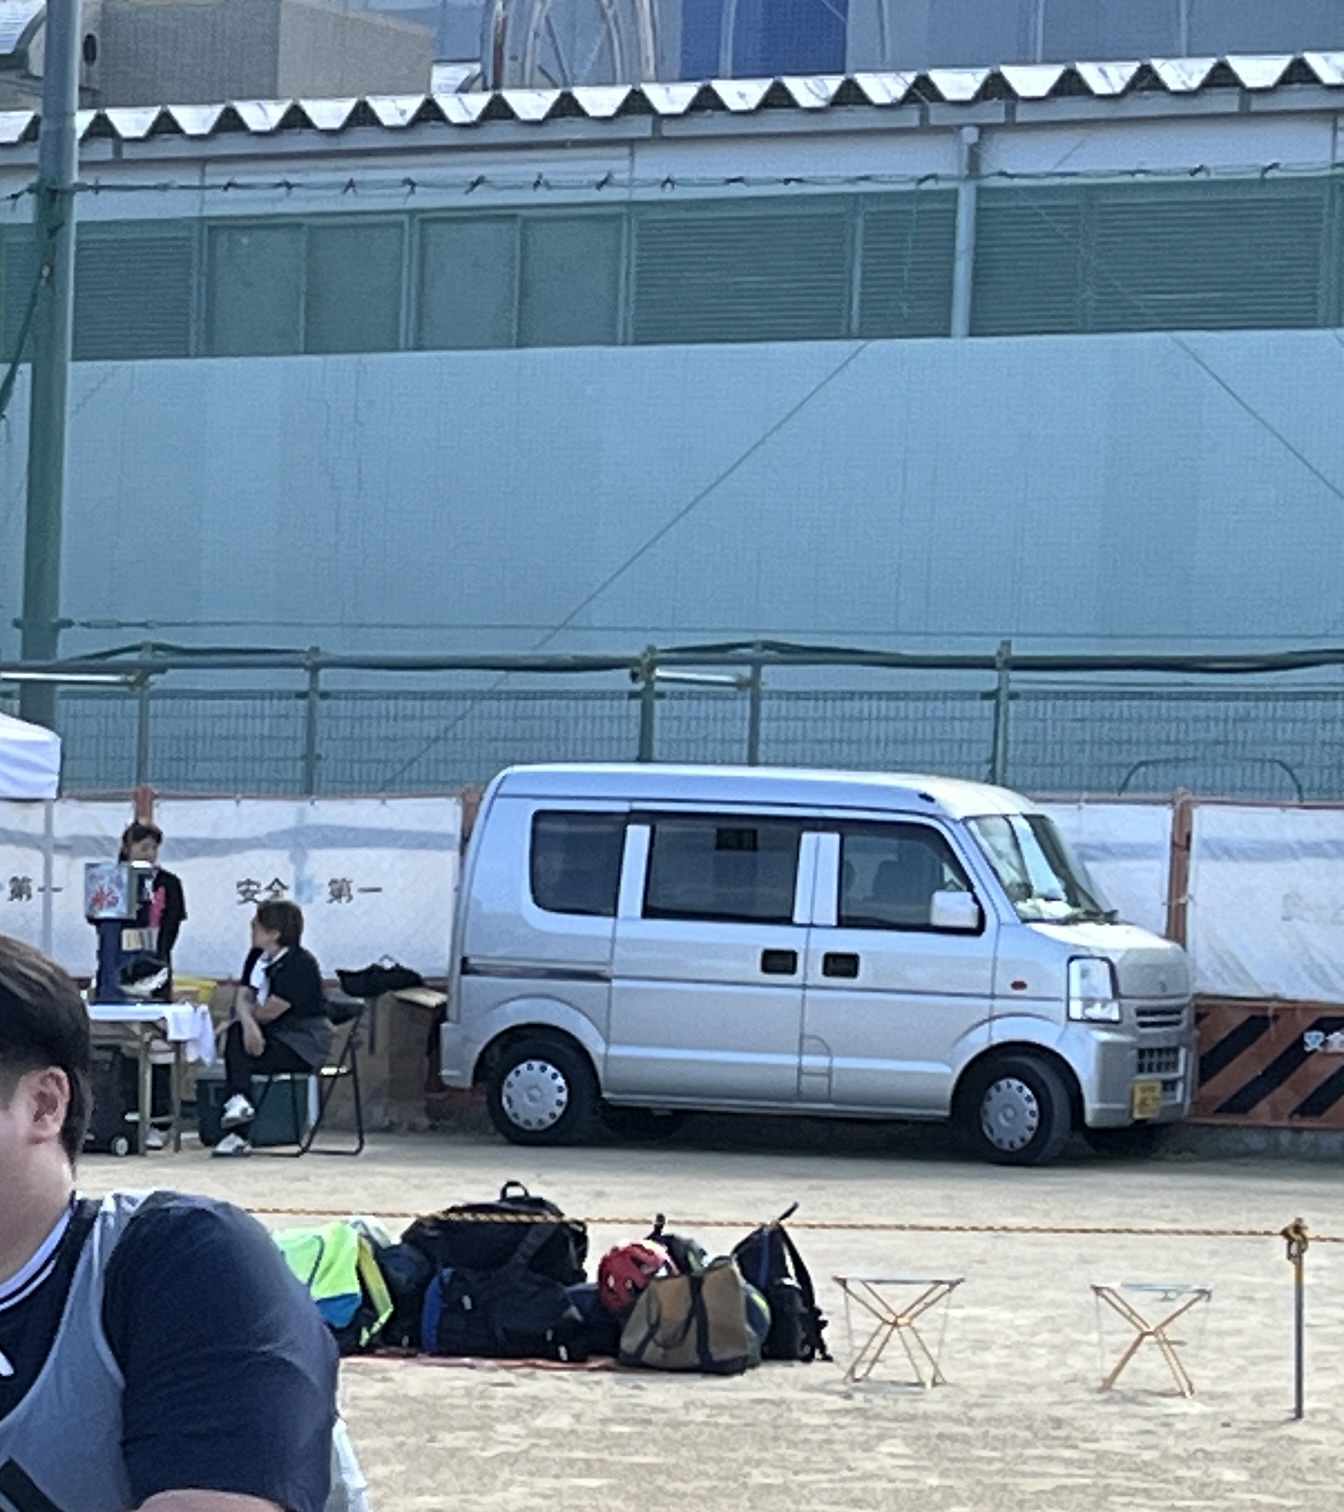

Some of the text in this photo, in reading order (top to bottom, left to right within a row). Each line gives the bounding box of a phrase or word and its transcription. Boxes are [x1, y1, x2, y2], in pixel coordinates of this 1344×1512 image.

[8, 875, 63, 902] 第一
[236, 877, 383, 905] 安全 第一
